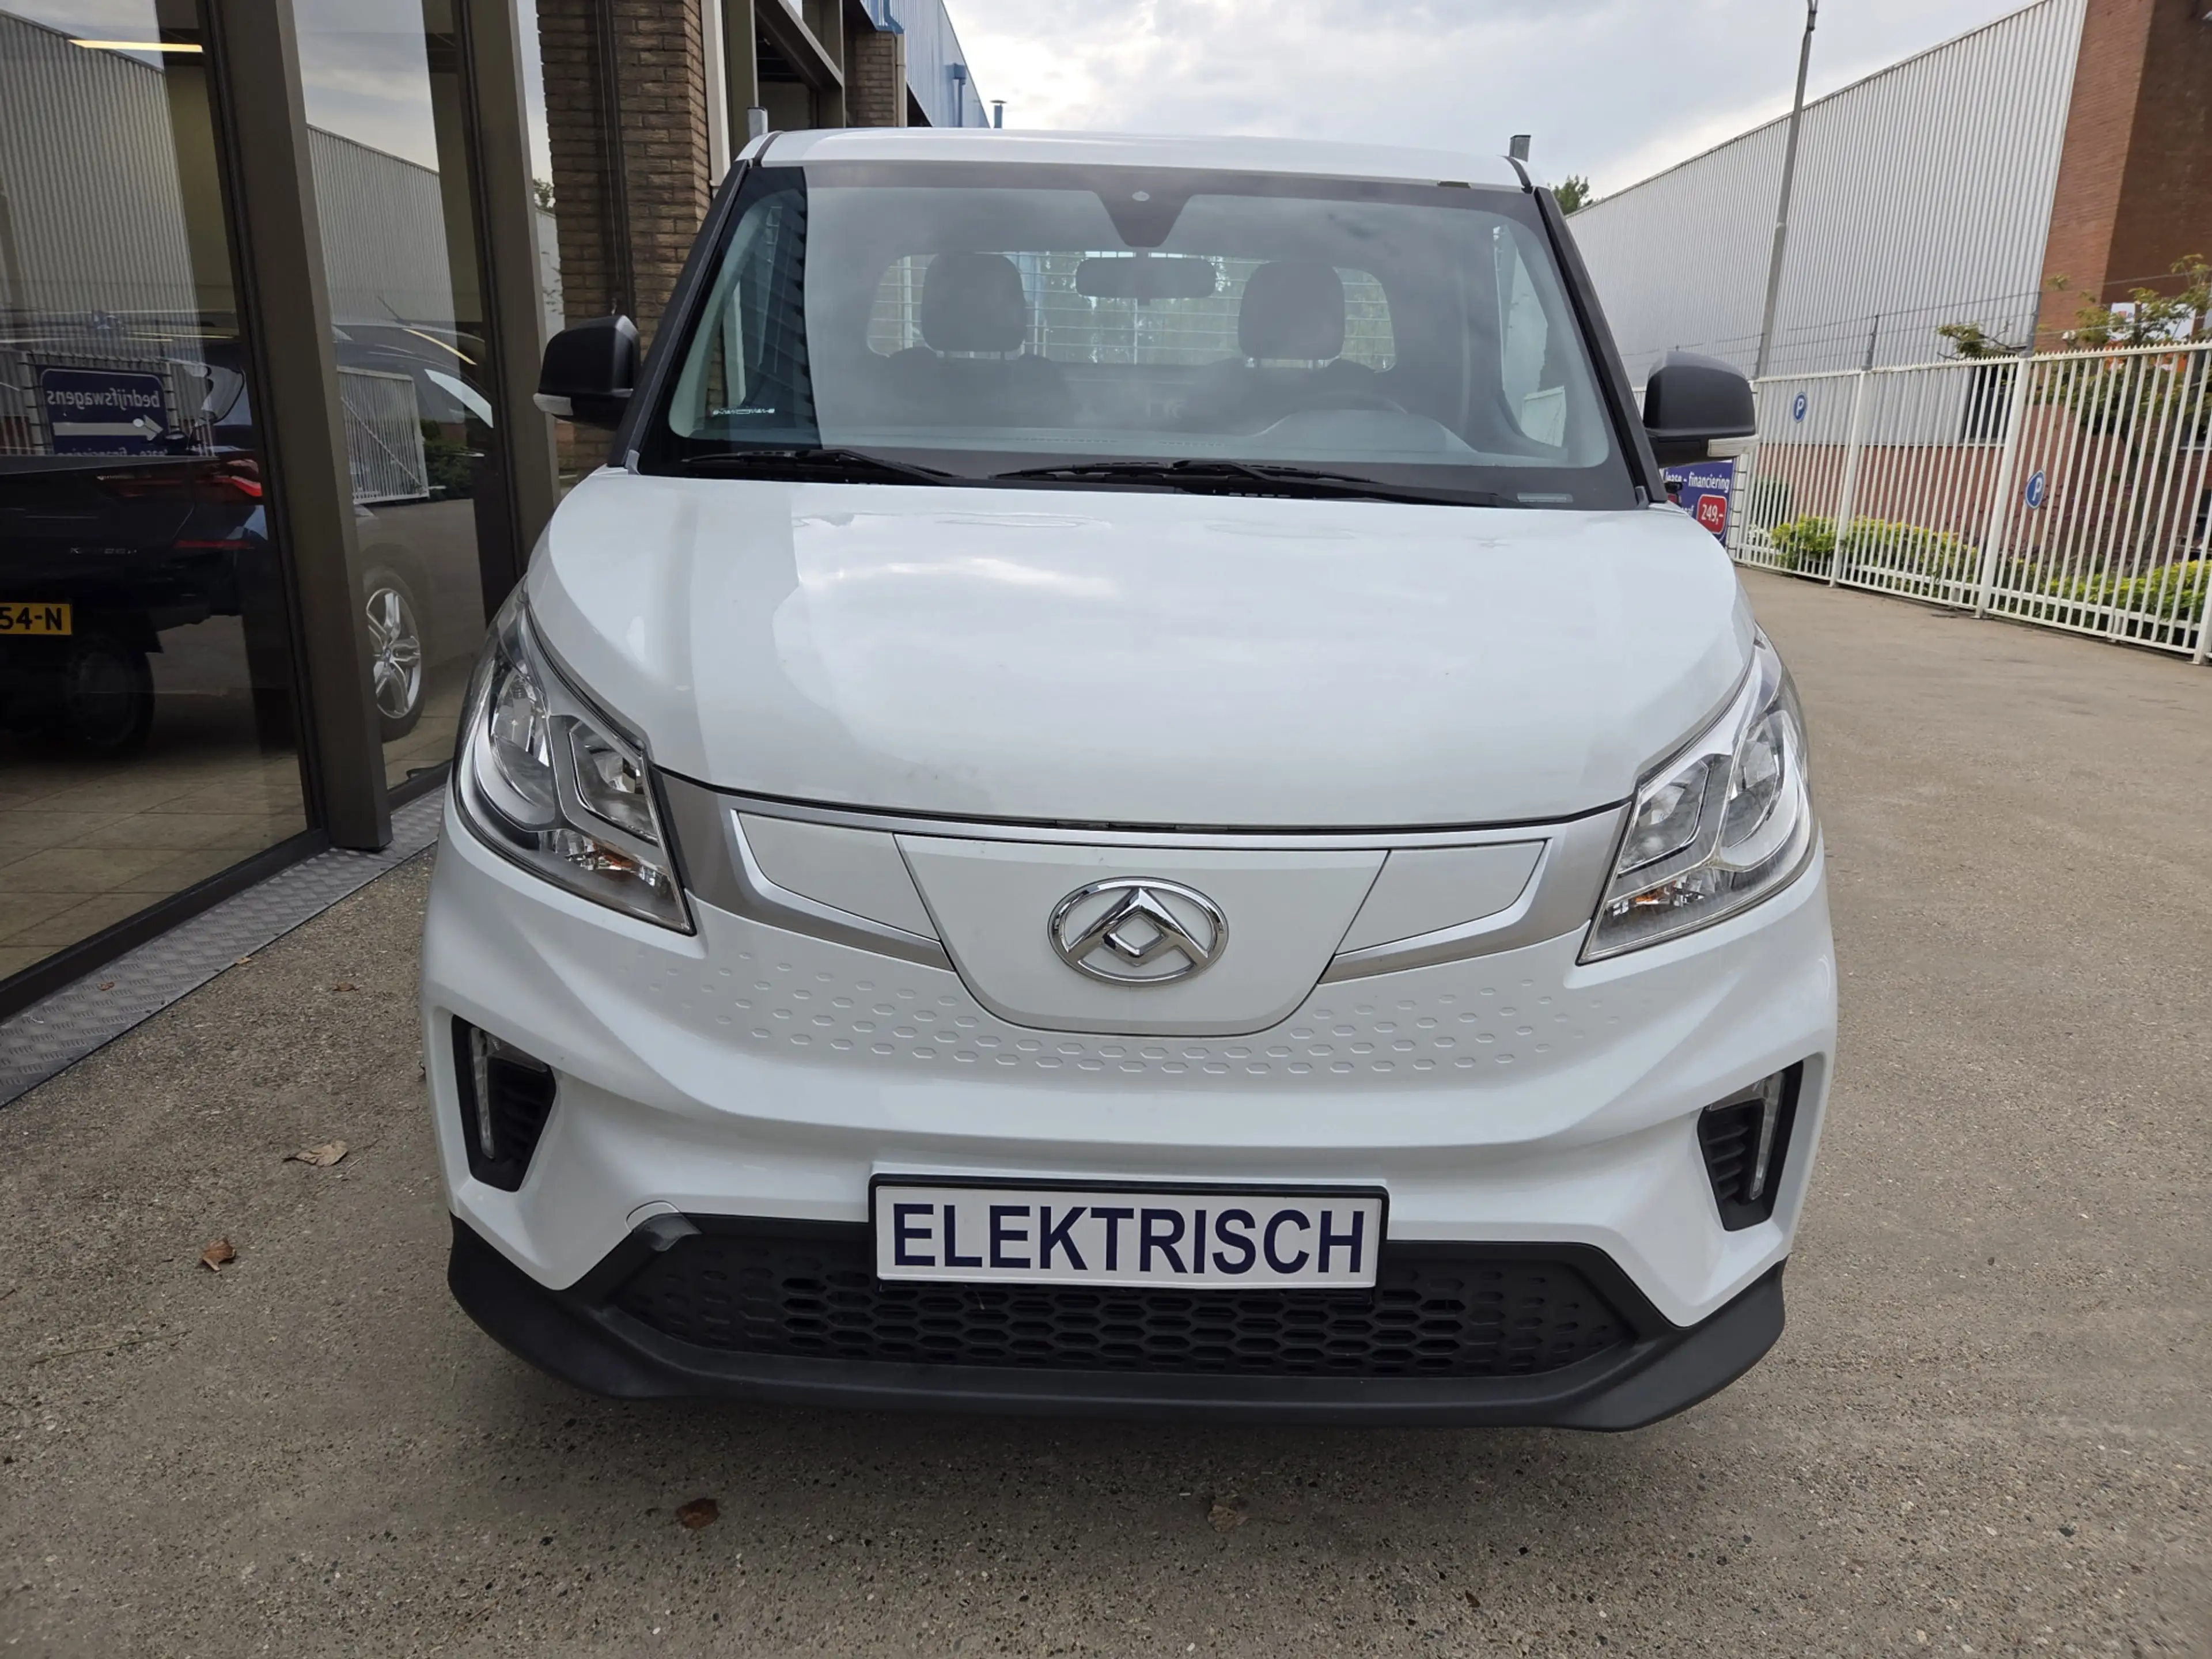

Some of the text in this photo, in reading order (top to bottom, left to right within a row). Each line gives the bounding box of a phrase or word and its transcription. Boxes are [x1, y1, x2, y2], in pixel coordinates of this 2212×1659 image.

[1796, 398, 1805, 416] P
[1688, 471, 1730, 494] financiering
[2032, 477, 2043, 502] P
[0, 607, 62, 631] 54-N
[892, 1203, 1365, 1275] ELEKTRISCH
